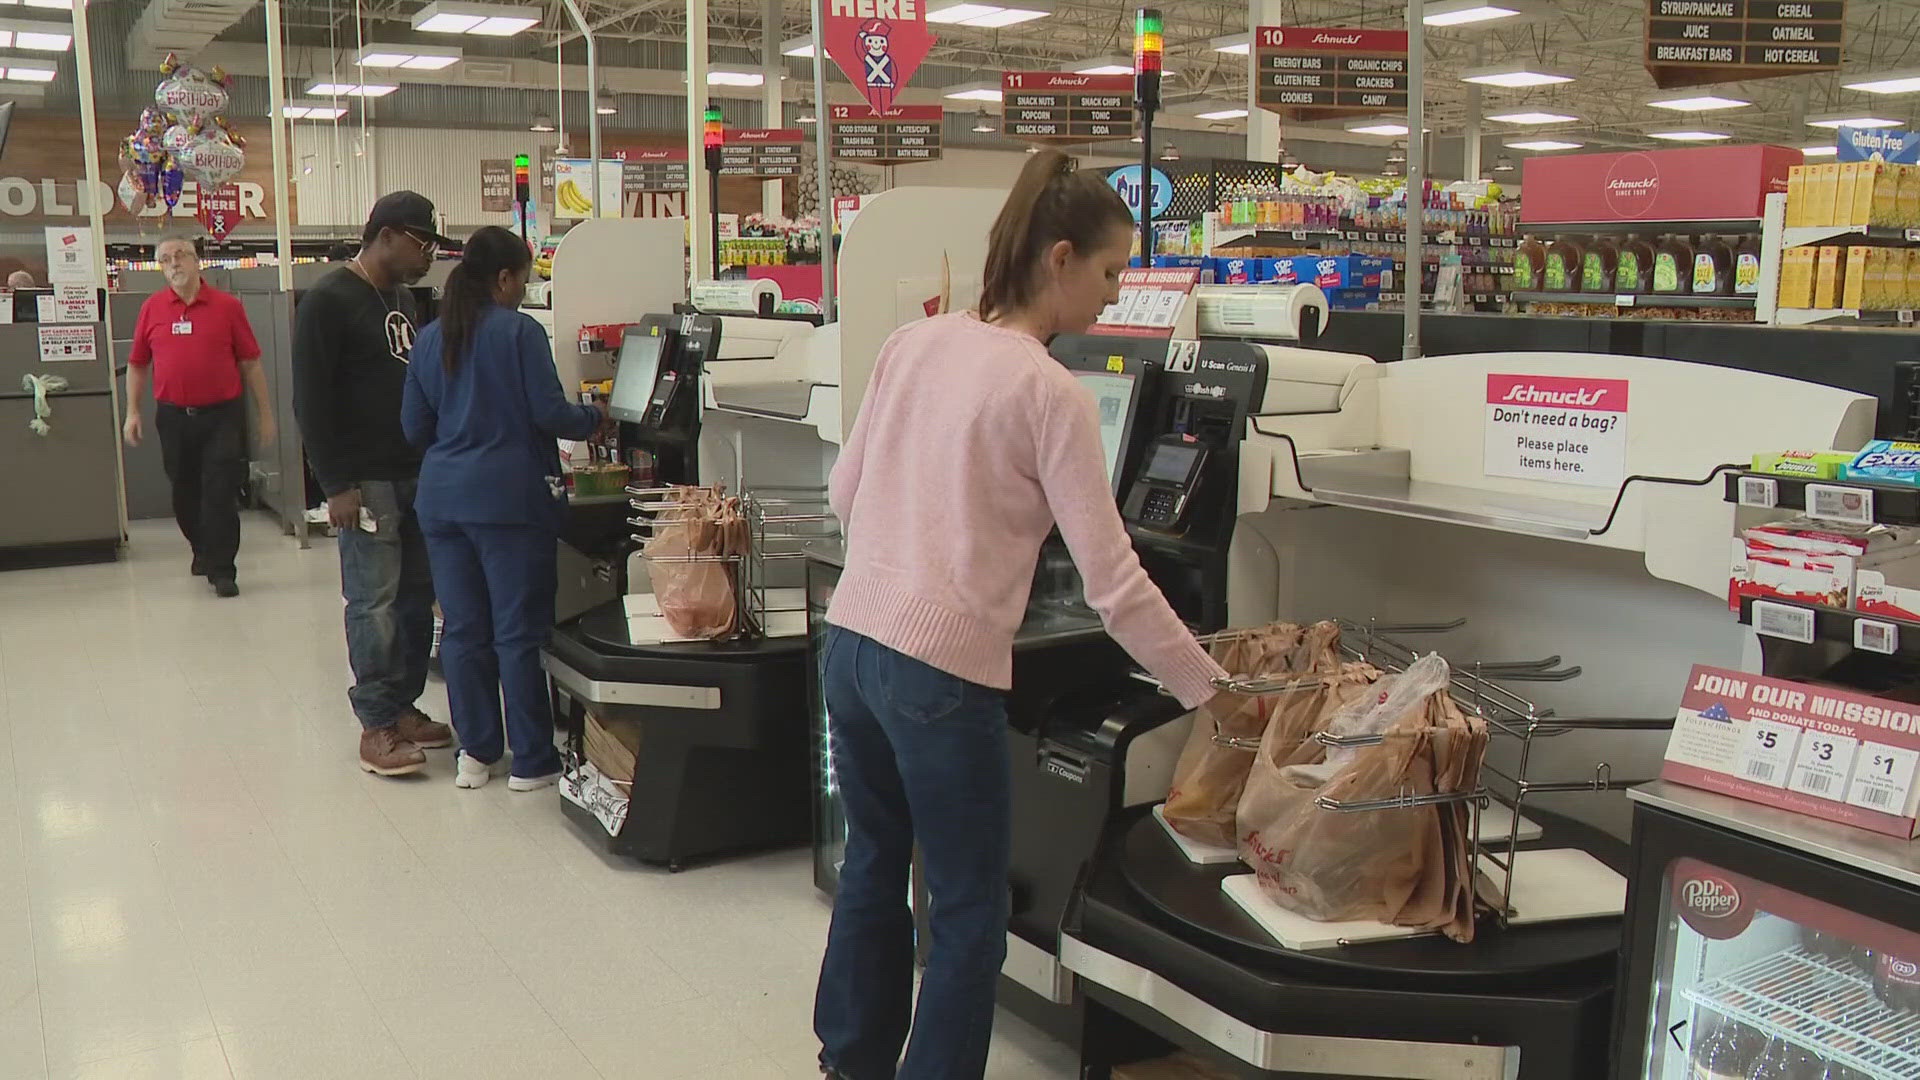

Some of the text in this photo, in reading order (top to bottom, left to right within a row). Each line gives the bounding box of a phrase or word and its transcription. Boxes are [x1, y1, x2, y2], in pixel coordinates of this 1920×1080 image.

[832, 0, 916, 21] HERE
[1661, 1, 1734, 16] SYRUP/PANCAKE
[1778, 4, 1812, 18] CEREAL
[1683, 24, 1710, 39] JUICE
[1772, 27, 1815, 41] OATMEAL
[1263, 30, 1284, 46] 10
[1312, 34, 1362, 44] Schnucks
[1657, 46, 1733, 62] BREAKFAST BARS
[1765, 49, 1820, 64] HOT CEREAL
[1274, 57, 1322, 69] ENERGY BARS
[1348, 60, 1402, 72] ORGANIC CHIPS
[1007, 75, 1022, 87] 11
[1048, 77, 1090, 86] Schnucks
[1274, 74, 1320, 86] GLUTEN FREE
[1356, 77, 1394, 88] CRACKERS
[1018, 97, 1055, 106] SNACK NUTS
[1081, 98, 1120, 106] SNACK CHIPS
[1281, 92, 1313, 104] COOKIES
[1362, 94, 1388, 106] CANDY
[834, 107, 848, 118] 12
[1022, 111, 1050, 120] POPCORN
[1092, 112, 1110, 120] TONIC
[840, 126, 878, 134] FOOD STORAGE
[896, 126, 930, 134] PLATES/CUPS
[1016, 126, 1056, 134] SNACK CHIPS
[1092, 126, 1110, 134] SODA
[843, 138, 874, 146] TRASH BAGS
[902, 138, 924, 146] NAPKINS
[1852, 131, 1902, 150] Gluten Free
[616, 152, 626, 160] 14
[840, 149, 878, 157] PAPER TOWELS
[484, 174, 510, 183] WINE
[1607, 178, 1656, 189] Schnucks
[484, 188, 510, 196] BEER
[201, 200, 236, 210] HERE
[1124, 272, 1194, 284] OUR MISSION
[1169, 342, 1196, 372] 73
[1202, 360, 1208, 368] U
[1208, 360, 1224, 370] Scan
[1226, 361, 1248, 373] Genesis
[1503, 384, 1608, 406] Schnucks
[1494, 408, 1618, 433] Don't need a bag?
[1517, 436, 1588, 454] Please place
[1520, 454, 1584, 472] items here.
[1693, 673, 1920, 736] JOIN OUR MISSION
[1746, 708, 1856, 738] AND DONATE TODAY.
[1756, 730, 1778, 748] $5
[1812, 741, 1834, 760] $3
[1873, 755, 1894, 775] $1
[1058, 768, 1082, 784] Coupons
[1703, 880, 1723, 896] Dr
[1688, 880, 1736, 912] Pepper
